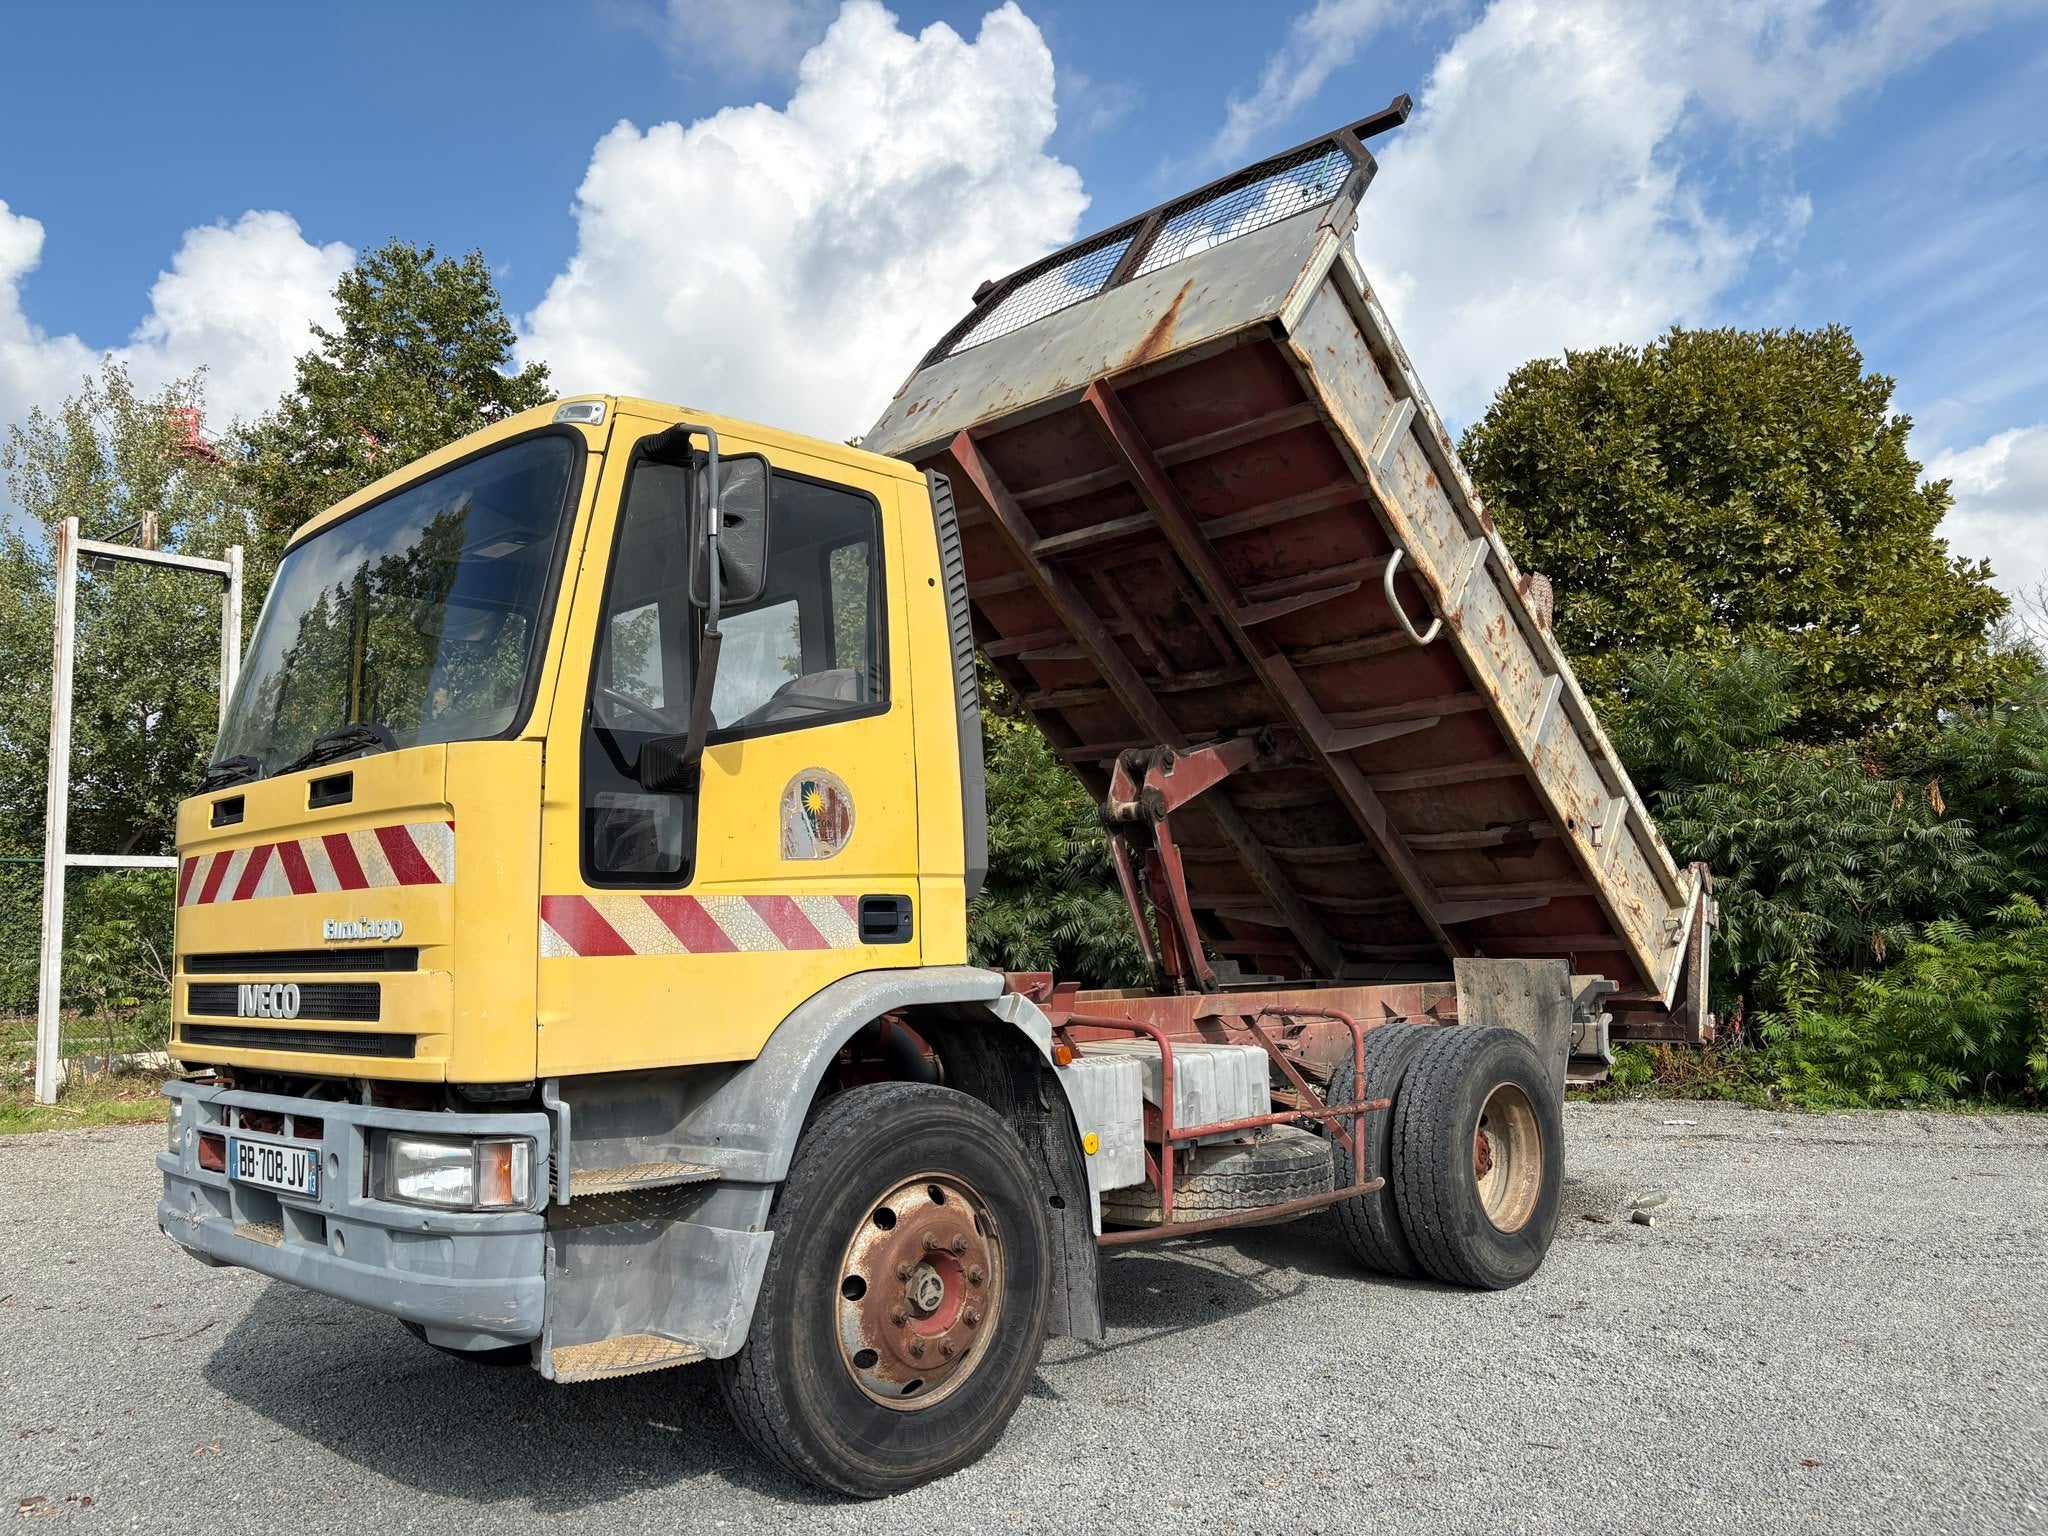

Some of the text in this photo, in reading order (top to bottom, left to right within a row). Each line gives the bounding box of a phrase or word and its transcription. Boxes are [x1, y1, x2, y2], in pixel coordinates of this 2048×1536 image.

[238, 984, 300, 1019] IVECO
[240, 1144, 305, 1187] BB-708-JV
[309, 1171, 316, 1192] 13
